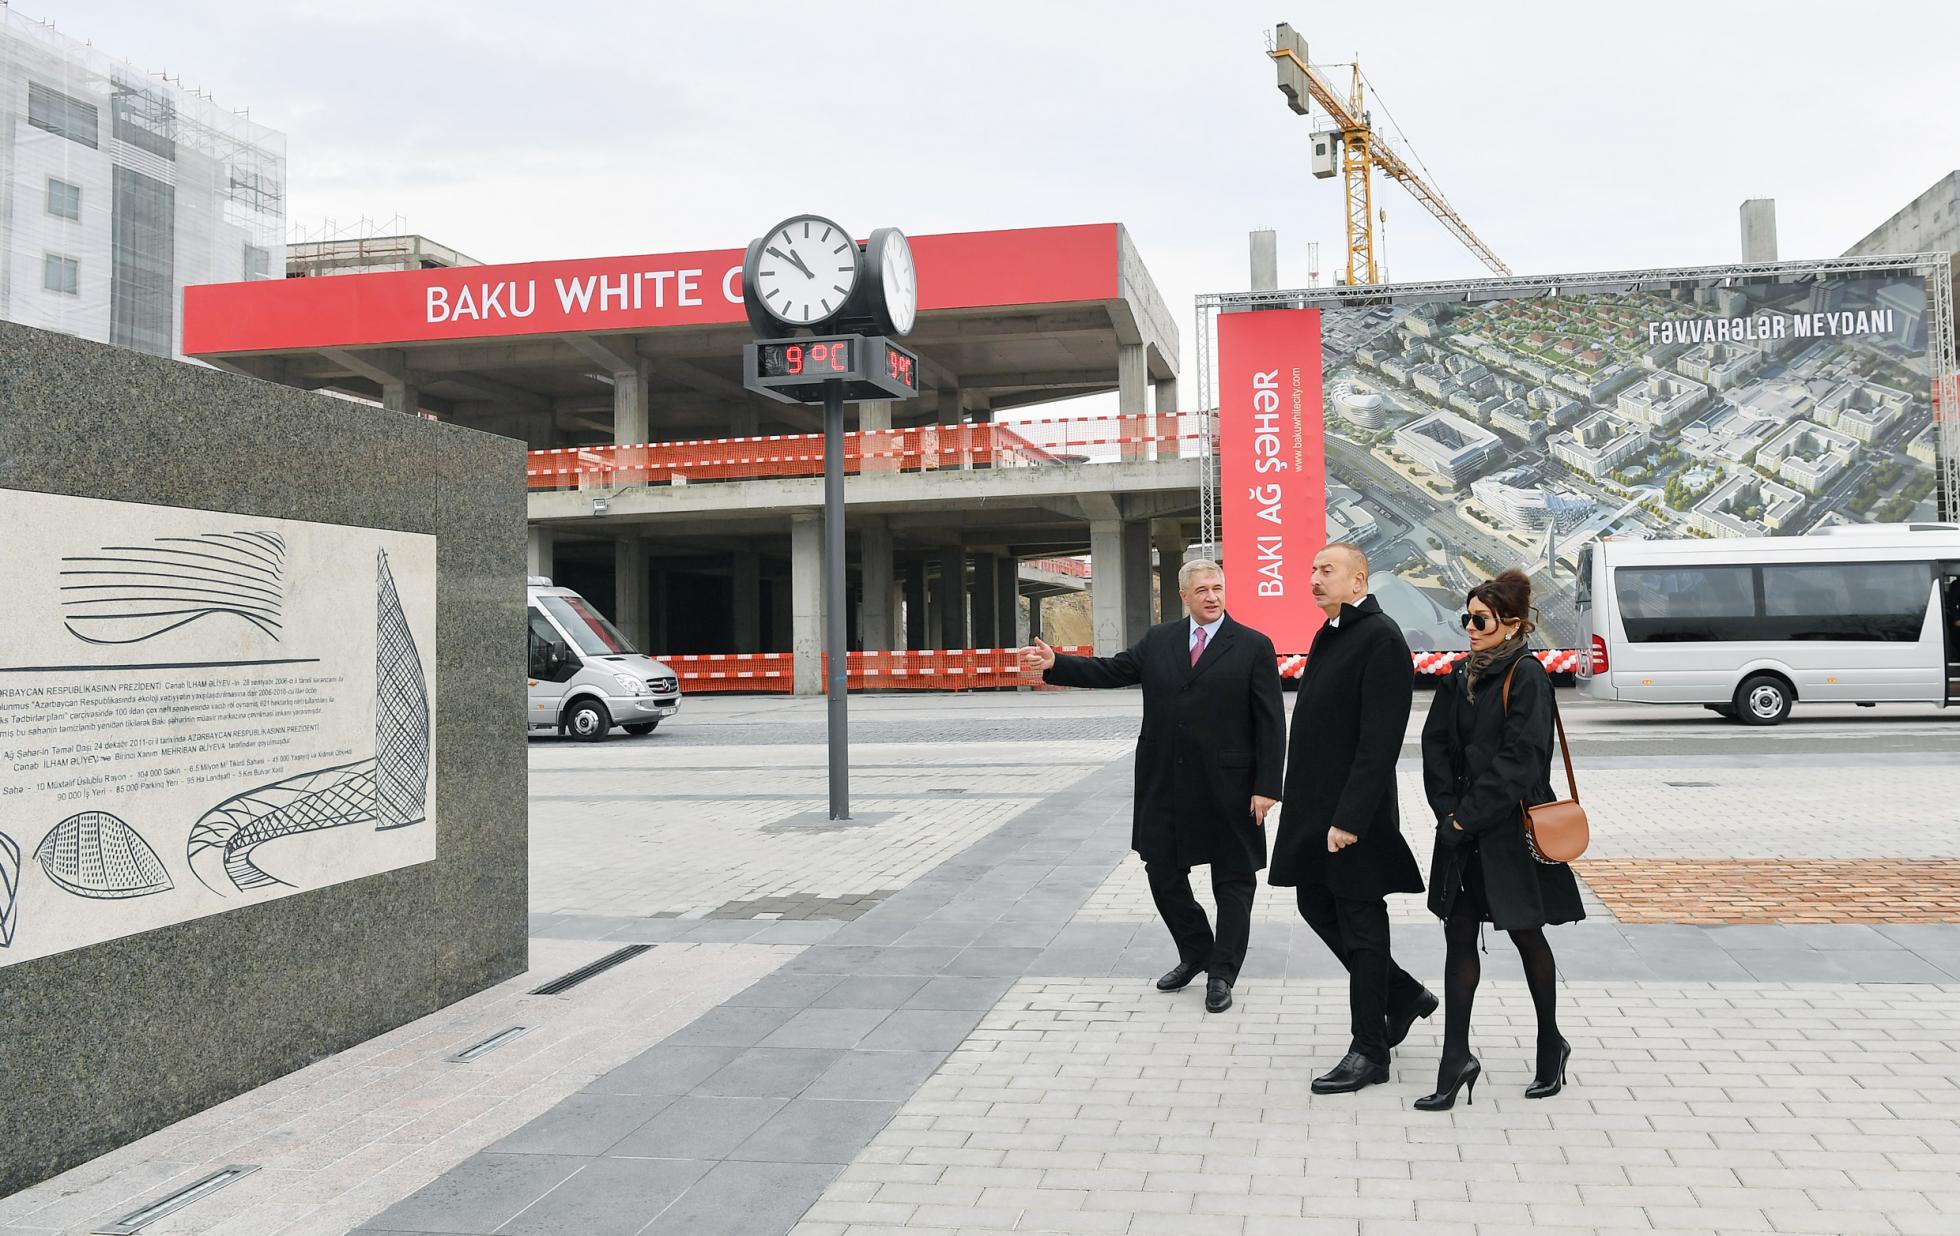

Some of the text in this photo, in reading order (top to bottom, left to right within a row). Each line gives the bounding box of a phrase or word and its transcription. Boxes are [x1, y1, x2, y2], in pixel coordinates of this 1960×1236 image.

[427, 280, 535, 323] BAKU
[554, 268, 703, 314] WHITE
[1649, 309, 1893, 345] FƏVVARƏLƏR MEYDANI
[1291, 367, 1304, 473] www.bakuwhitecity.com
[1249, 369, 1288, 597] BAKI AĞ ŞƏHƏR
[115, 708, 127, 716] 100
[16, 727, 26, 737] bu
[94, 742, 102, 751] 24
[37, 782, 45, 791] 10
[57, 793, 67, 801] 90
[68, 790, 82, 800] 000
[126, 783, 139, 792] 000
